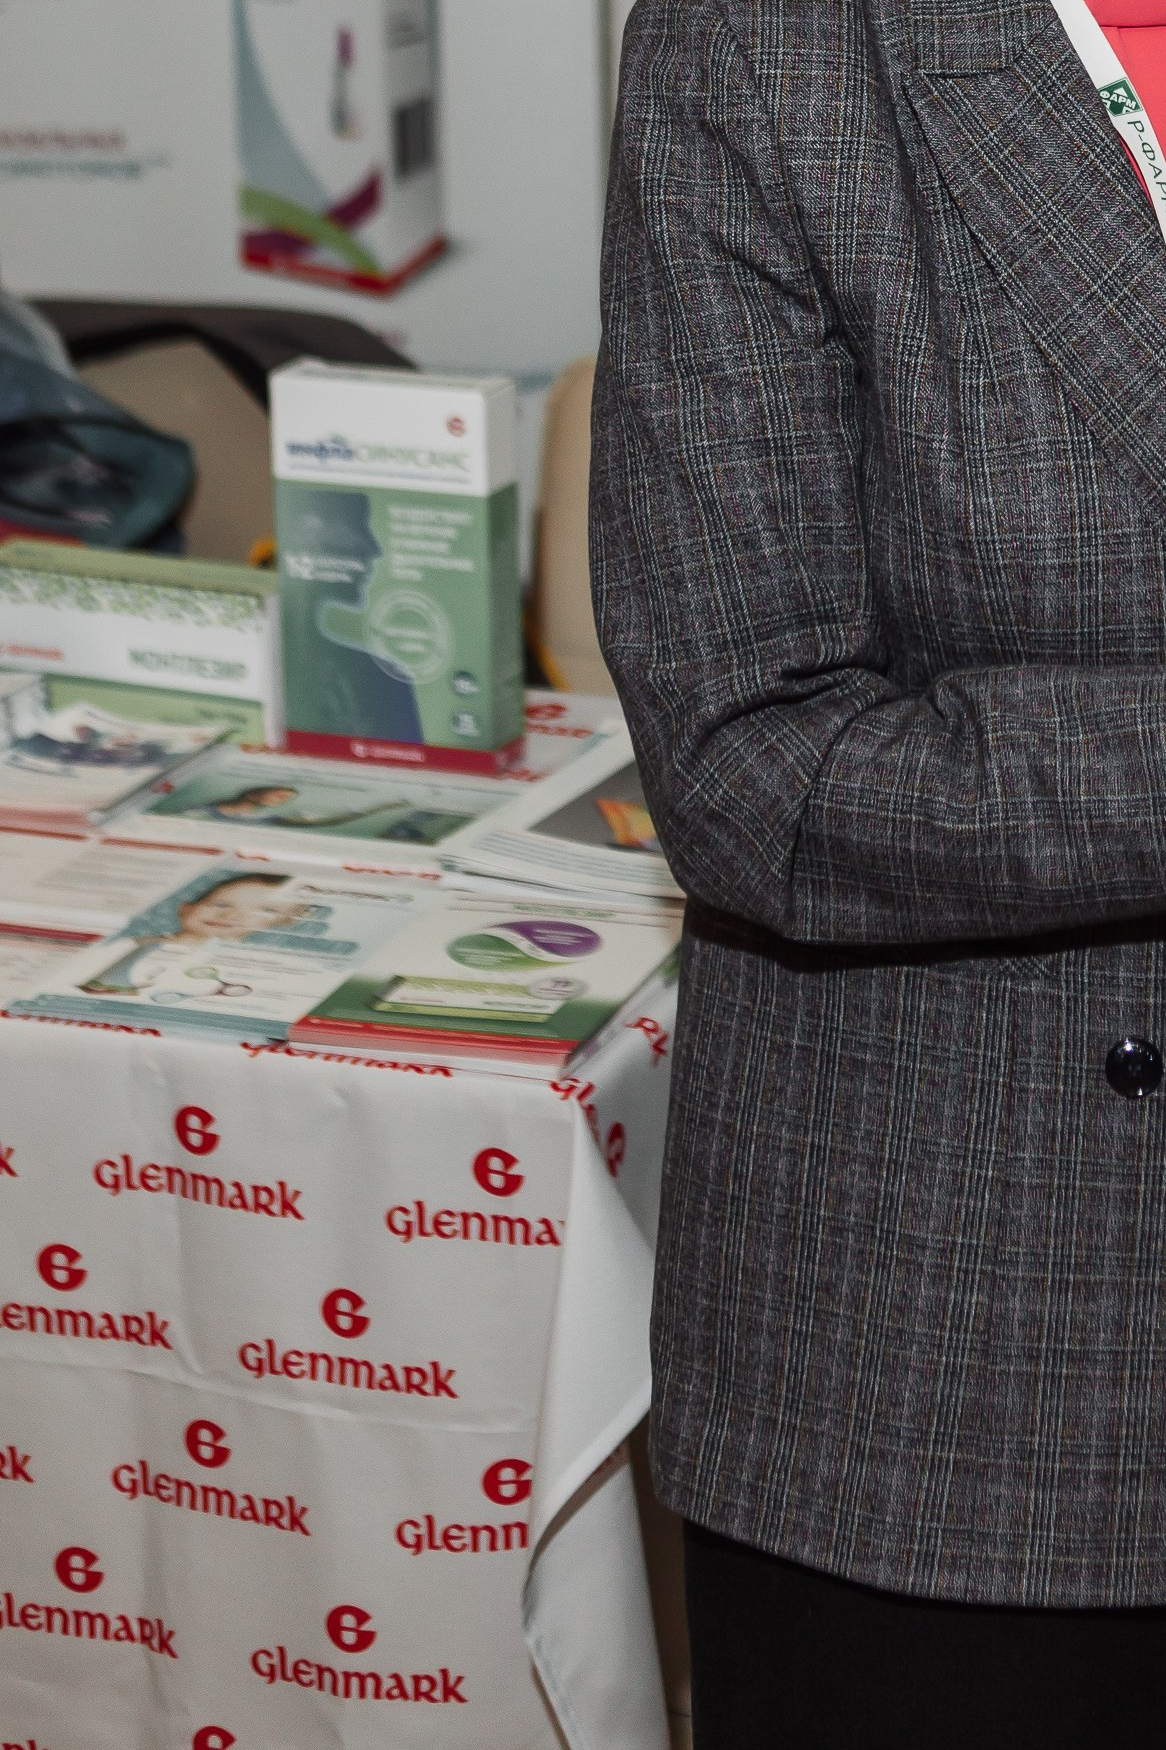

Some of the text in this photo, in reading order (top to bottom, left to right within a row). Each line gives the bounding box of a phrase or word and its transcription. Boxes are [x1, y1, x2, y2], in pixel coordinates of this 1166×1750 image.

[94, 1155, 305, 1221] Glenmark
[238, 1338, 459, 1399] Glenmark
[111, 1460, 312, 1536] Glenmark
[0, 1594, 179, 1659] lenmark
[251, 1645, 468, 1704] Glenmark
